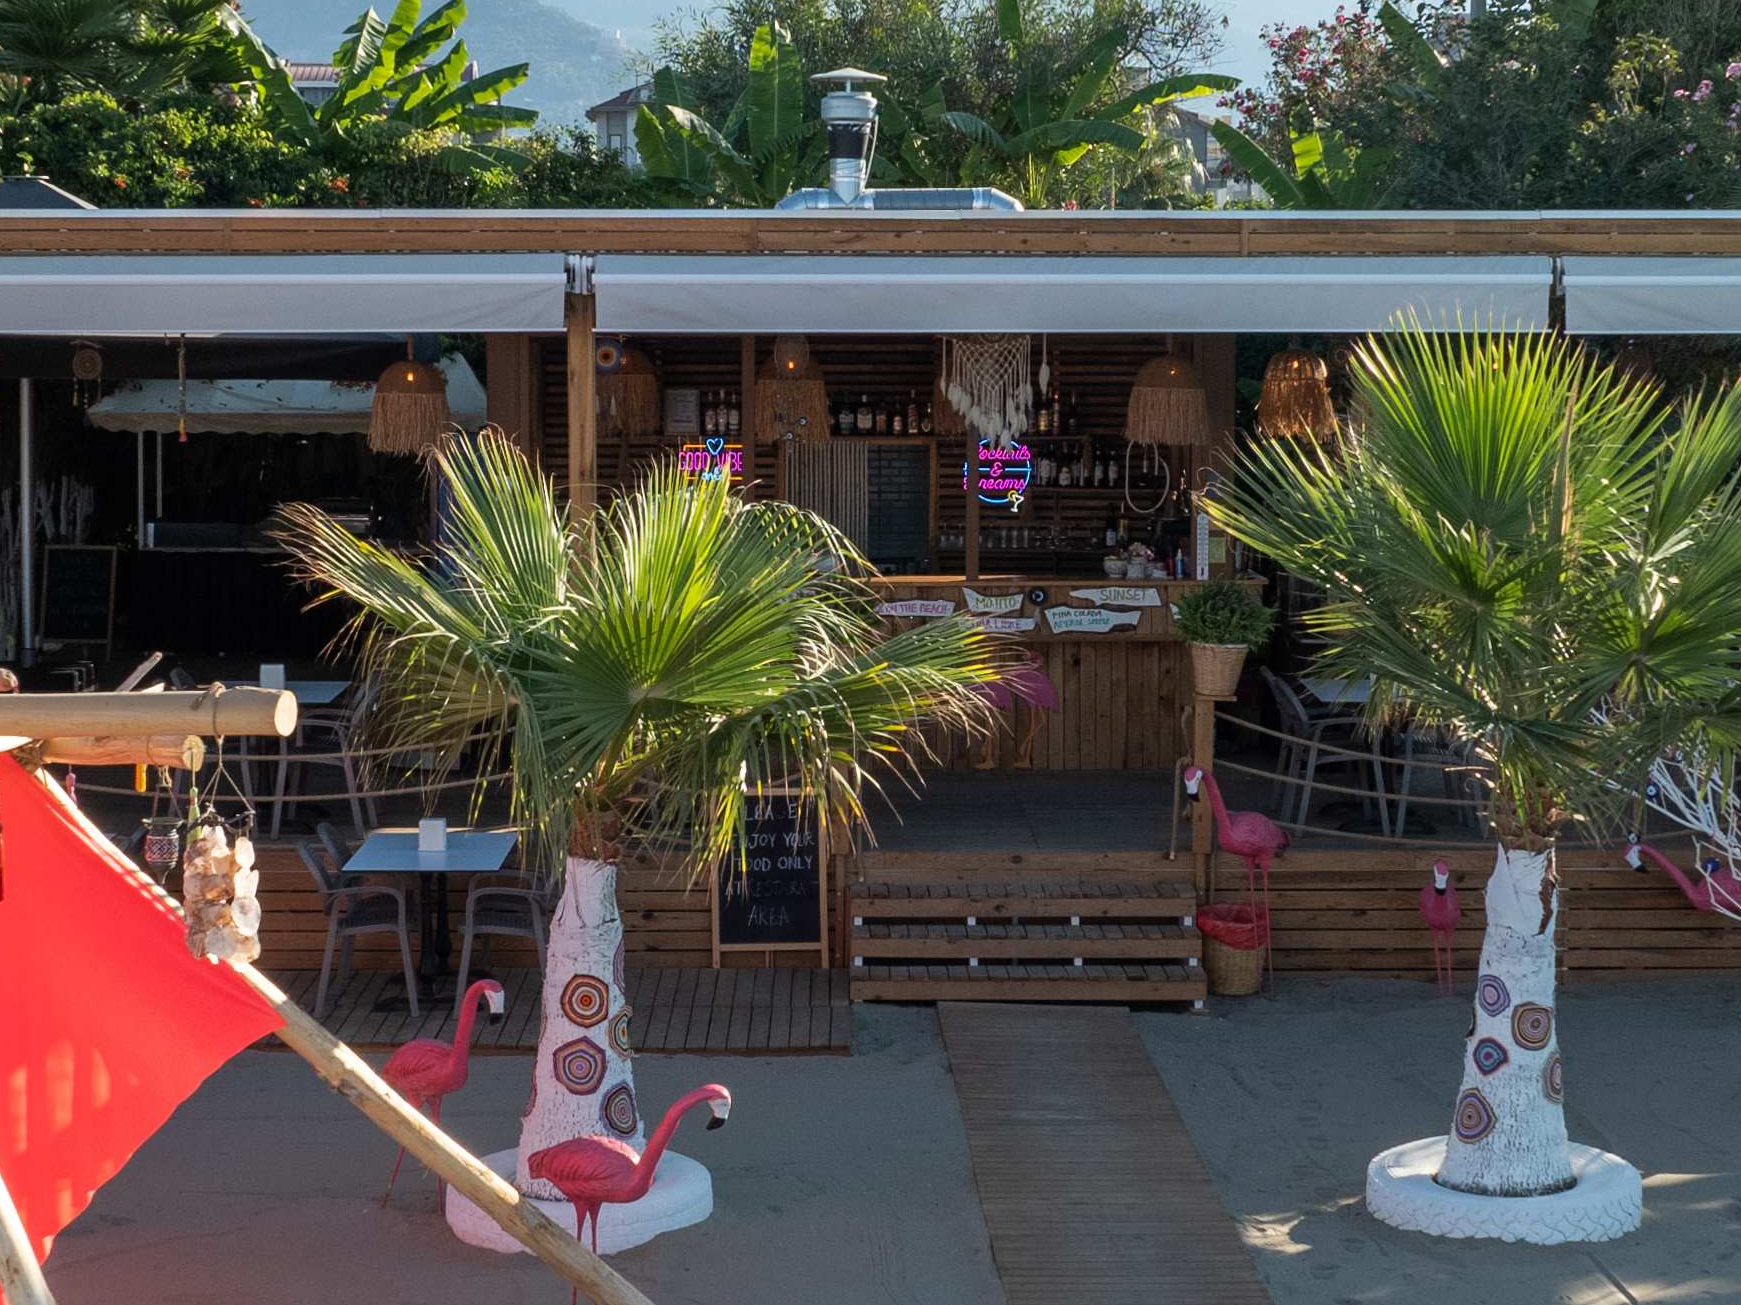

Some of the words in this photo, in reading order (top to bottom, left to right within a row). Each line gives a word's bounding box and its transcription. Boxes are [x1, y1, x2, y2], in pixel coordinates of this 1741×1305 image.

[678, 451, 710, 472] GOOD
[989, 461, 1004, 477] &
[975, 597, 1016, 609] MOJITO
[1099, 589, 1147, 602] SUNSET
[899, 603, 918, 614] THE
[920, 603, 948, 614] BEACH
[783, 832, 816, 847] YOUR
[777, 856, 813, 871] ONLY
[747, 904, 790, 928] AREA
